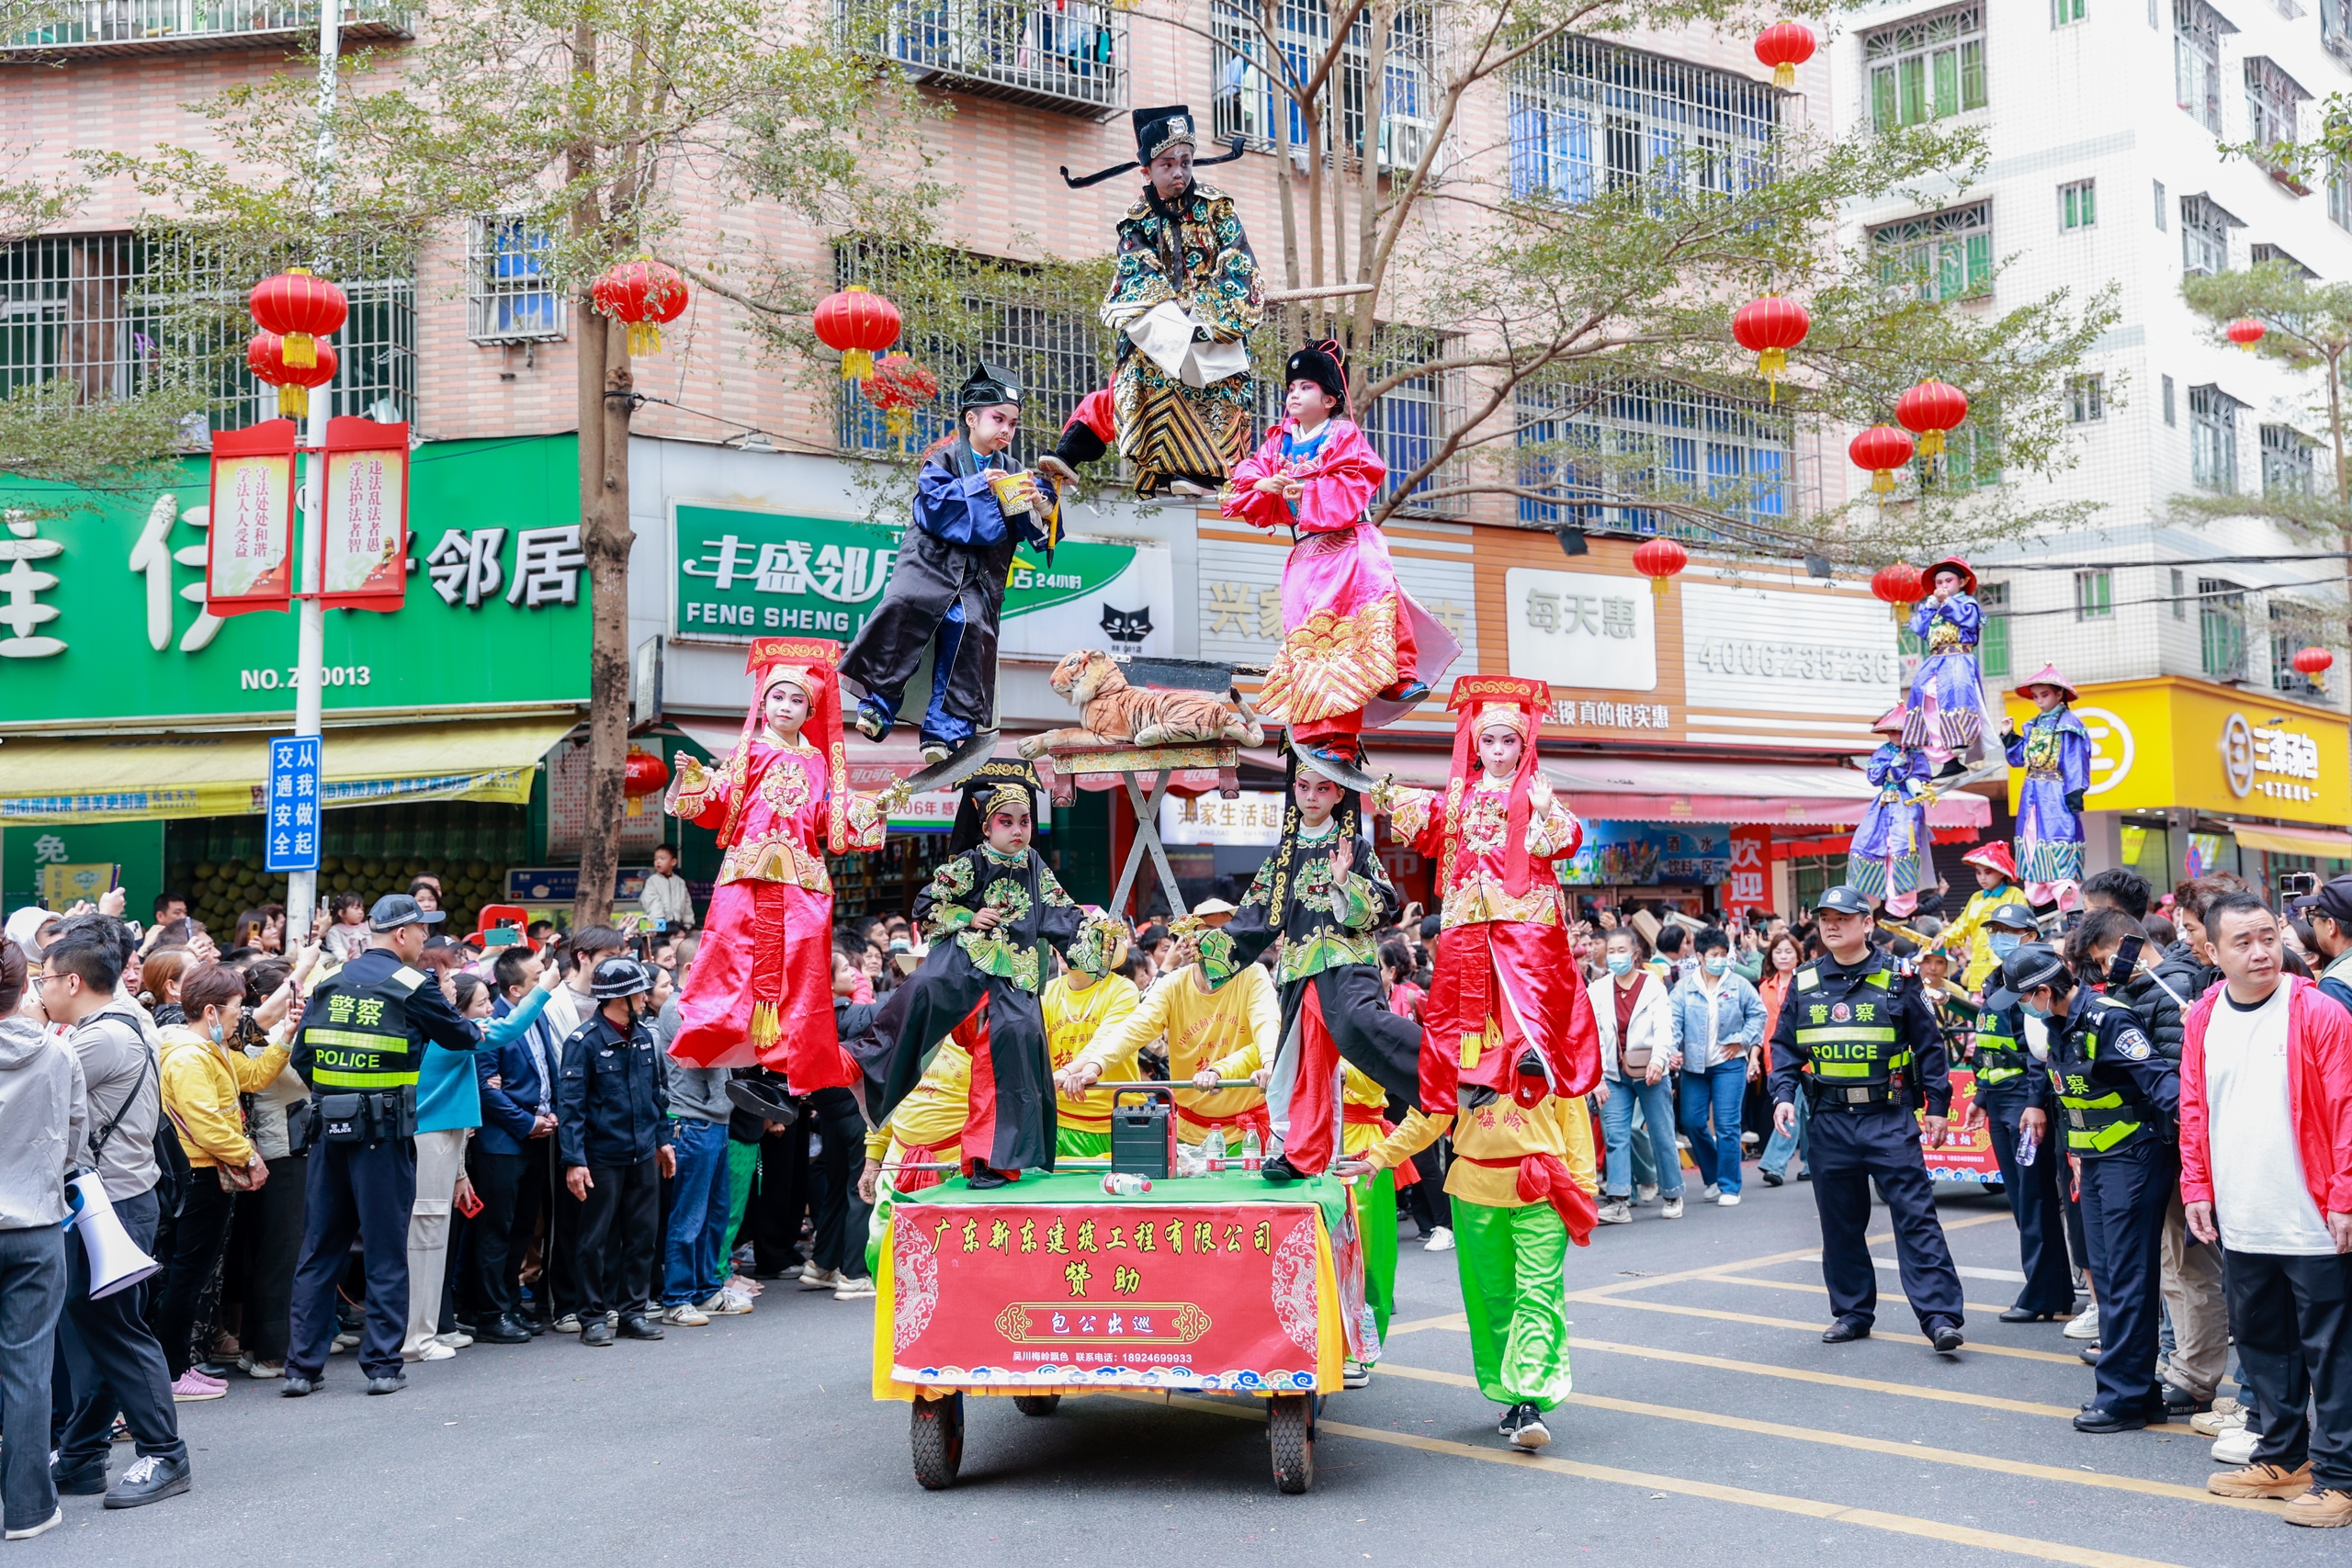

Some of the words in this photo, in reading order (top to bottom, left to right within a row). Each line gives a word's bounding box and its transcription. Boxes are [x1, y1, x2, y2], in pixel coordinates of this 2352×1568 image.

[234, 467, 252, 558] 学法人人受益
[254, 467, 270, 558] 守法处处和谐
[347, 461, 365, 553] 学法护法者智
[366, 460, 383, 553] 违法乱法者愚
[406, 524, 588, 608] 邻居
[1035, 573, 1082, 590] 24小时
[686, 602, 755, 626] FENG
[763, 607, 849, 632] SHENG
[1526, 587, 1636, 638] 每天惠
[1699, 637, 1892, 683] 4006235236
[241, 665, 371, 691] NO.Z0013
[1579, 702, 1669, 728] 真的很实惠
[273, 745, 294, 856] 交通安全
[294, 743, 315, 855] 从我做起
[1178, 801, 1286, 829] 兴家生活超
[328, 995, 384, 1026] 警察
[1809, 1003, 1875, 1024] 警察
[1178, 1013, 1247, 1045] 中国民间文化术乡
[1198, 1037, 1228, 1052] 广东川
[316, 1049, 380, 1068] POLICE
[1812, 1044, 1878, 1060] POLICE
[1476, 1108, 1530, 1133] 梅岭
[931, 1217, 1272, 1256] 广东新东建筑工程有限公司
[1065, 1260, 1141, 1297] 赞助
[1051, 1312, 1155, 1335] 包公出巡
[1012, 1351, 1069, 1363] 吴川梅岭飘色
